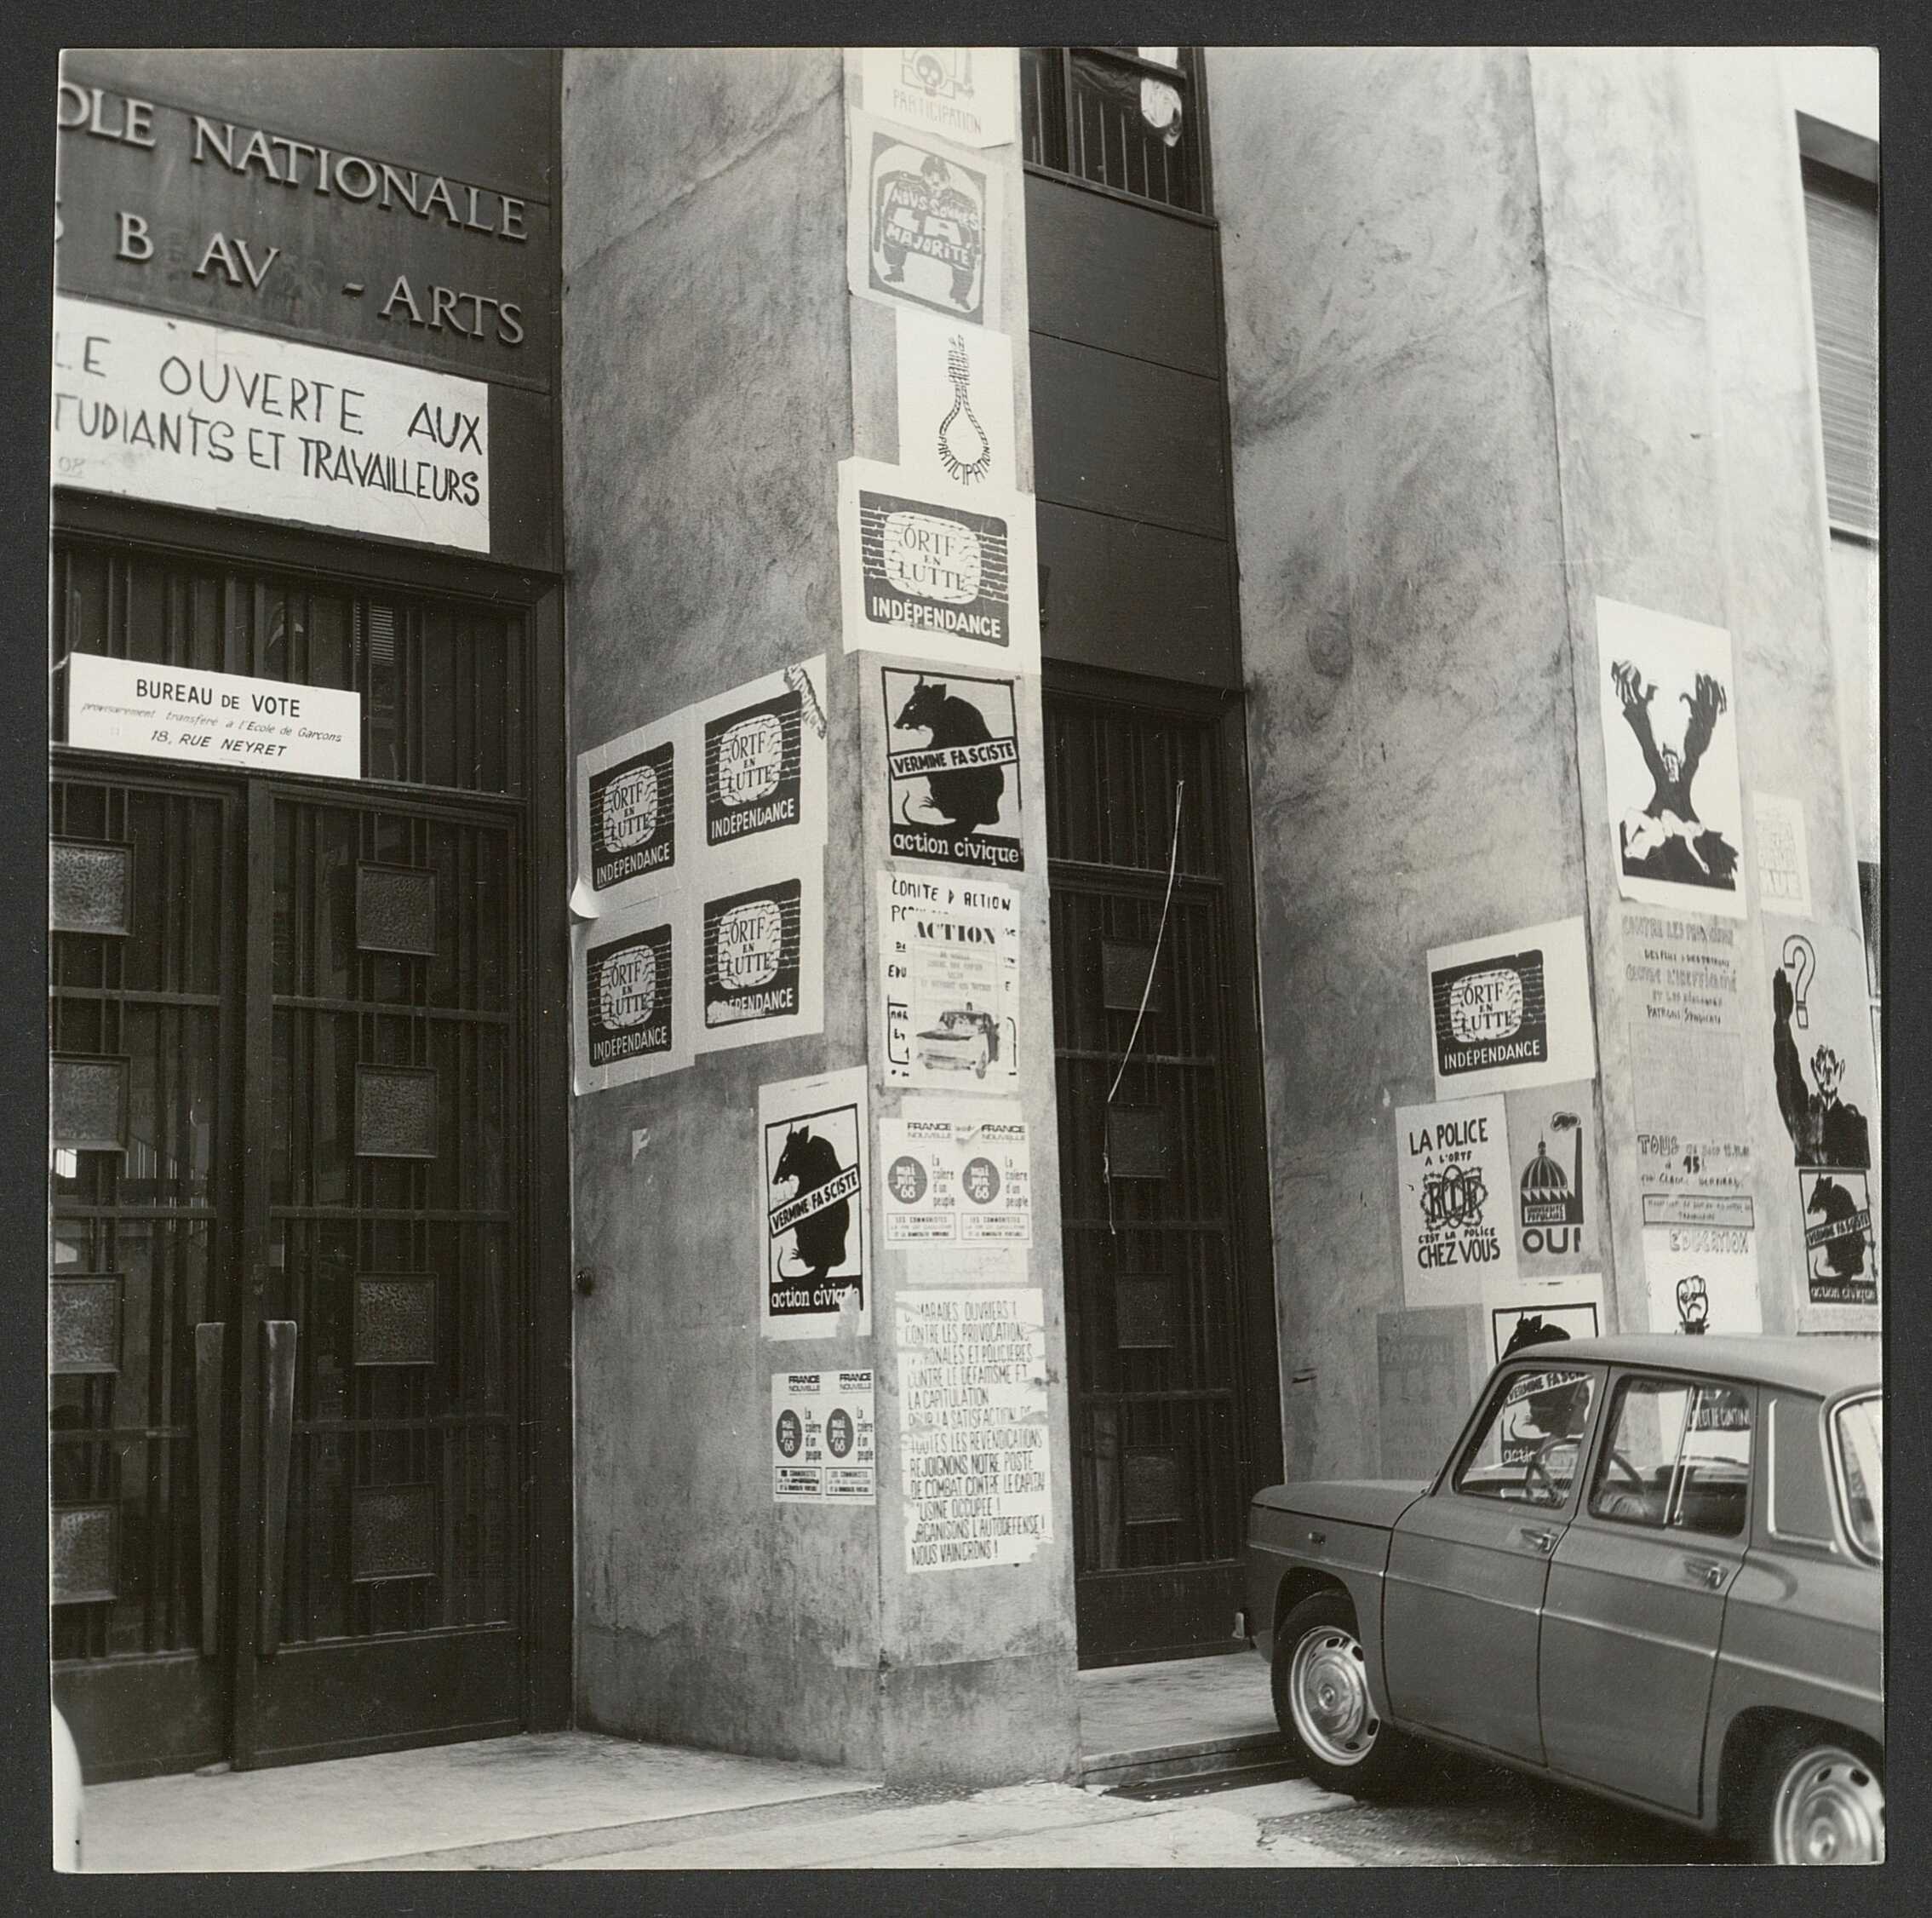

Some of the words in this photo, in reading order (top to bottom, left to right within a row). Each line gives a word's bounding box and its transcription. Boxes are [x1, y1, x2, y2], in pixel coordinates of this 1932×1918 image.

[893, 89, 982, 135] PARTICIPATION
[58, 84, 157, 148] OLE
[191, 116, 528, 242] NATIONALE
[888, 206, 963, 246] LA
[378, 276, 525, 345] ARTS
[159, 355, 366, 437] OUVERTE
[406, 402, 484, 456] AUX
[54, 393, 235, 463] TUDIANTS
[248, 428, 285, 471] ET
[297, 435, 481, 508] TRAVAILLEURS
[937, 434, 991, 486] PARTICIPATION
[903, 523, 957, 558] ORTF
[900, 560, 969, 592] LUTTE
[924, 555, 942, 566] EN
[872, 595, 1002, 640] INDÉPENDANCE
[135, 679, 213, 705] BUREAU
[221, 694, 241, 710] DE
[251, 693, 301, 718] VOTE
[177, 732, 212, 749] RUE
[220, 738, 288, 758] NEYRET
[279, 726, 293, 738] de
[894, 752, 948, 774] VERMINE
[951, 742, 1015, 764] FASCISTE
[711, 797, 795, 840] INDÉPENDANCE
[596, 841, 671, 884] INDÉPENDANCE
[893, 831, 949, 856] action
[954, 836, 1020, 866] civique
[891, 878, 939, 902] COMITE
[963, 891, 1012, 911] ACTION
[1463, 982, 1505, 1006] ORTF
[593, 1025, 668, 1060] INDÉPENDANCE
[1443, 1039, 1540, 1071] INDÉPENDANCE
[907, 1122, 952, 1131] FRANCE
[980, 1123, 1026, 1134] FRANCE
[1410, 1128, 1433, 1156] LA
[1436, 1117, 1488, 1151] POLICE
[771, 1197, 810, 1232] VERMINE
[811, 1169, 858, 1211] FASCISTE
[900, 1187, 916, 1199] 68
[1445, 1231, 1457, 1240] LA
[1464, 1226, 1496, 1238] POLICE
[1522, 1227, 1582, 1255] OUI
[1418, 1241, 1459, 1270] CHEZ
[1459, 1238, 1501, 1263] VOUS
[770, 1285, 811, 1309] action
[942, 1322, 959, 1345] LES
[947, 1366, 958, 1387] LE
[908, 1392, 921, 1410] LA
[950, 1432, 967, 1453] LES
[971, 1453, 1000, 1475] NOTRE
[1003, 1450, 1035, 1472] POSTE
[910, 1479, 922, 1500] DE
[925, 1476, 963, 1499] COMBAT
[965, 1474, 1000, 1496] CONTRE
[1003, 1473, 1014, 1494] LE
[910, 1542, 938, 1566] NOUS
